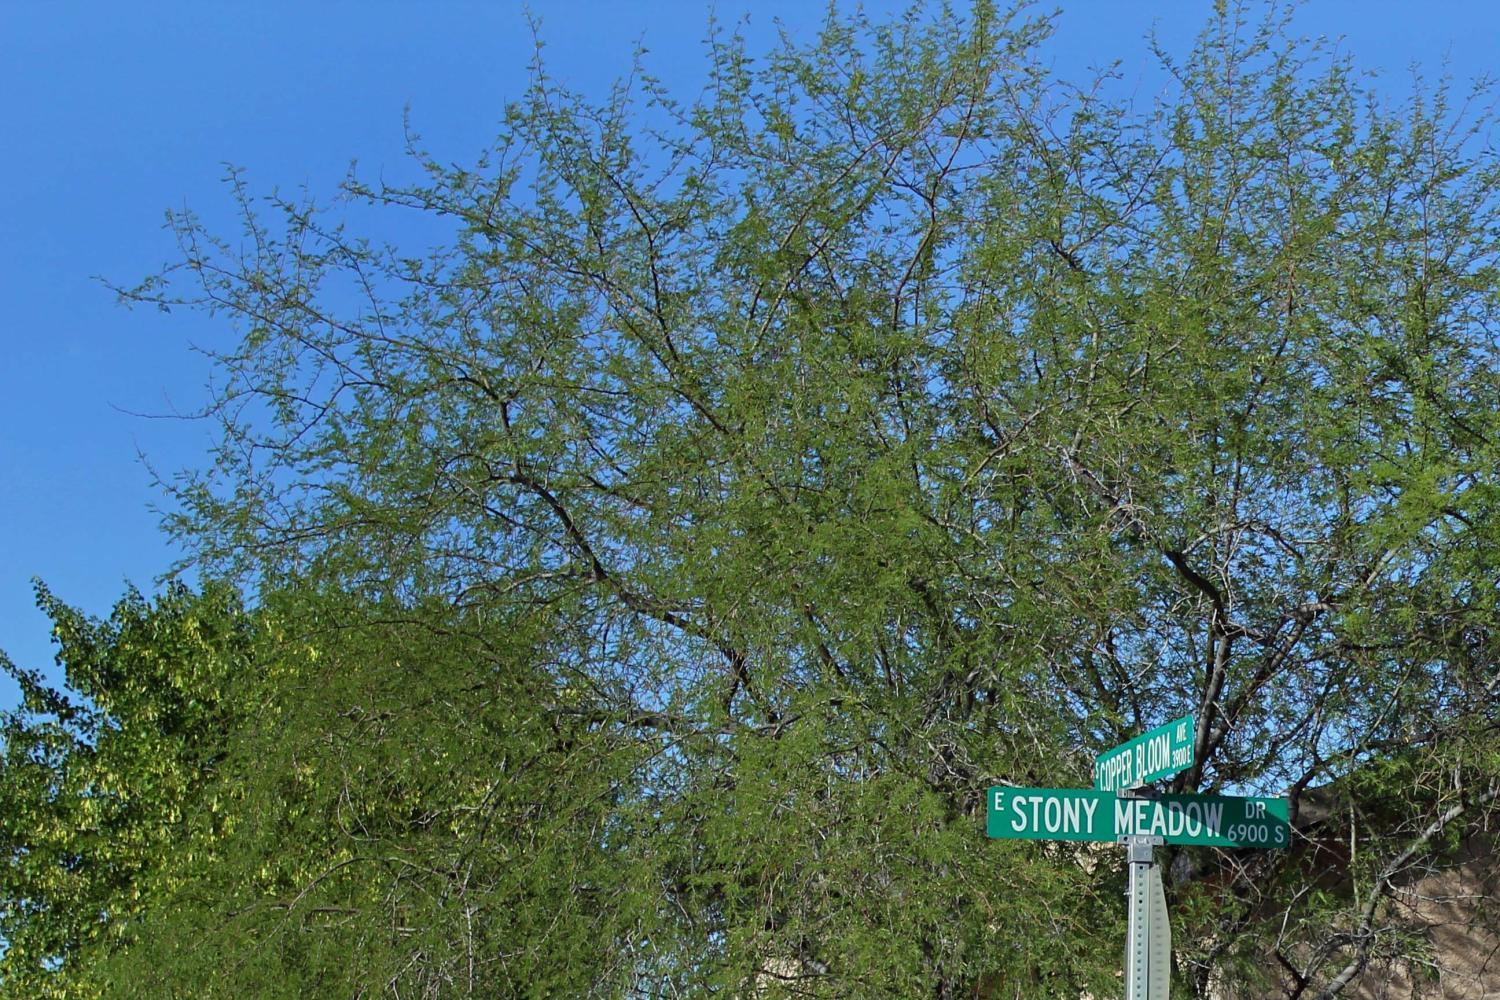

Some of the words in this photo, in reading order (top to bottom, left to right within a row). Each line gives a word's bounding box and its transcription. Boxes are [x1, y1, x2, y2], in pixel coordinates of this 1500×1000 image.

[1095, 762, 1099, 779] S
[1100, 749, 1133, 791] COPPER
[1136, 732, 1170, 779] BLOOM
[1176, 722, 1187, 743] AVE
[1172, 746, 1187, 769] 3900
[1187, 744, 1191, 763] E
[995, 792, 1004, 811] E
[1011, 796, 1099, 833] STONY
[1114, 800, 1224, 838] MEADOW
[1245, 801, 1266, 820] DR
[1227, 824, 1268, 843] 6900
[1274, 825, 1284, 844] S
